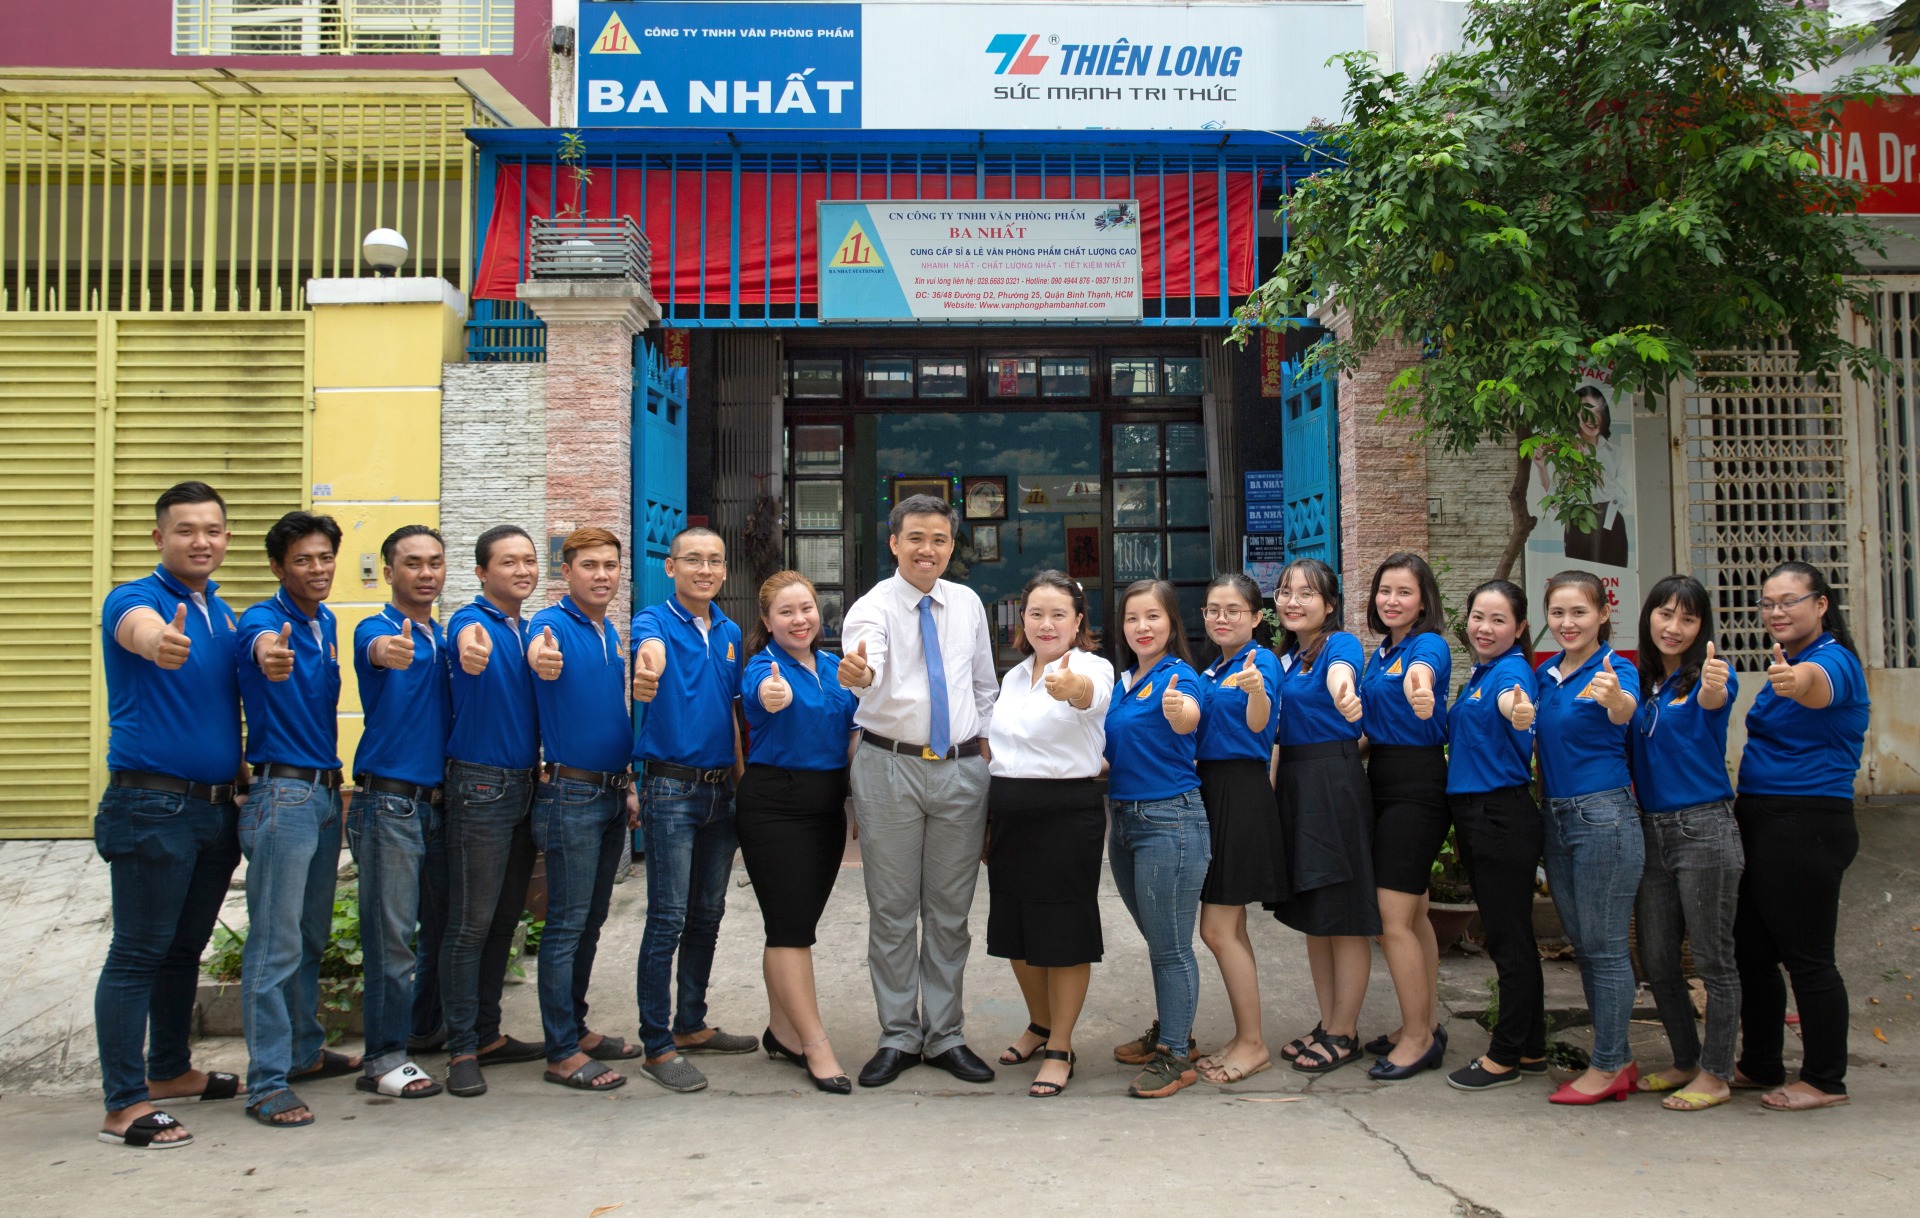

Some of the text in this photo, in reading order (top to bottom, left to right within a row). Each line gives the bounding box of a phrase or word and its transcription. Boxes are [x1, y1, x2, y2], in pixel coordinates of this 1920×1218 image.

[644, 27, 854, 38] CÔNG TY TNHH VĂN PHÒNG PHẨM
[1060, 38, 1243, 77] THIÊN LONG
[588, 67, 854, 114] BA NHẤT
[994, 82, 1040, 100] SỨC
[1129, 88, 1166, 100] TRI
[1173, 84, 1237, 101] THỨC
[1879, 132, 1920, 183] Dr
[888, 209, 1086, 220] CN CÔNG TY TNHH VĂN PHÒNG PHẨM
[949, 222, 1027, 238] BA NHẤT
[936, 246, 953, 256] CẤP
[986, 247, 1004, 256] VĂN
[1006, 246, 1036, 256] PHÒNG
[1038, 245, 1061, 256] PHẨM
[1064, 246, 1086, 256] CHẤT
[953, 260, 974, 269] NHẤT
[982, 260, 1004, 269] CHẤT
[1036, 260, 1056, 268] NHẤT
[1105, 260, 1126, 268] NHẤT
[983, 292, 996, 300] D2,
[1032, 292, 1042, 300] 25,
[1044, 291, 1064, 300] Quận
